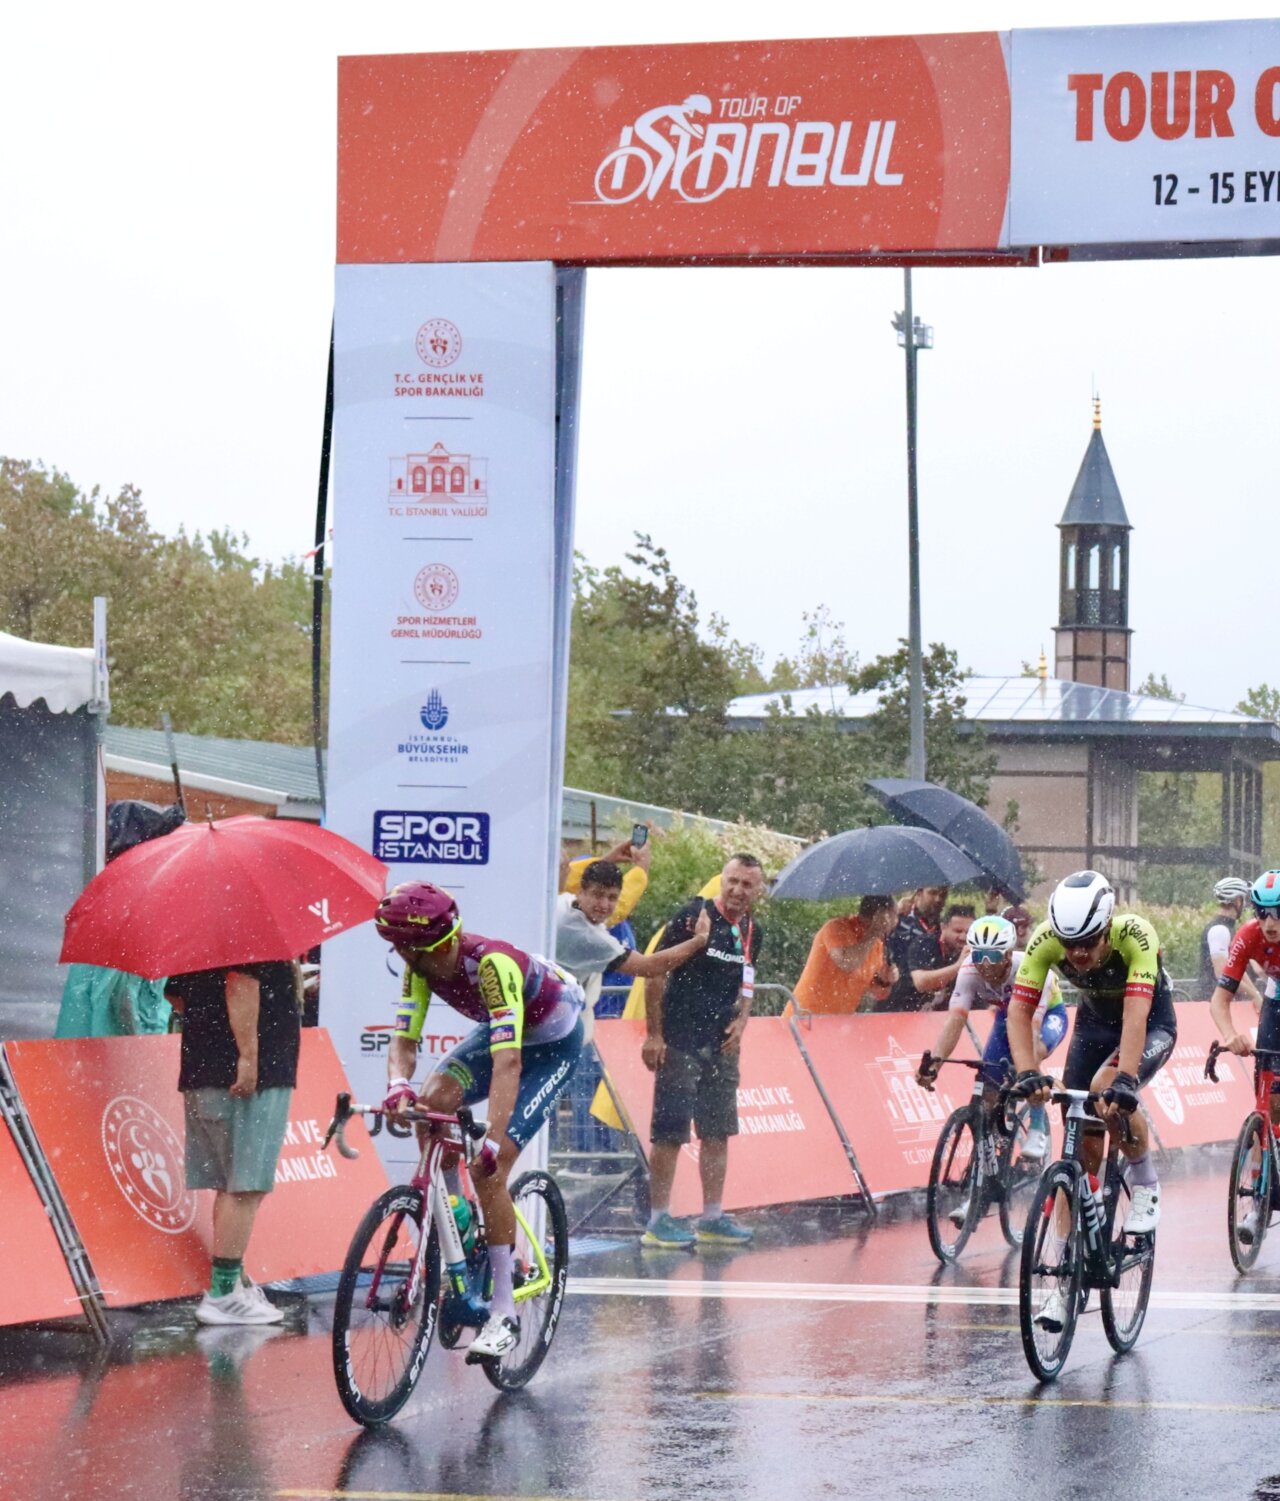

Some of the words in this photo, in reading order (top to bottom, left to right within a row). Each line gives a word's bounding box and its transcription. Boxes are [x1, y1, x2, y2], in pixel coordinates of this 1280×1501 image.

[717, 96, 766, 119] TOUR
[773, 95, 802, 117] OF
[1066, 70, 1236, 143] TOUR
[1152, 172, 1178, 206] 12
[1209, 171, 1236, 204] 15
[394, 373, 415, 384] T.C.
[418, 372, 467, 386] GENÇLİK
[470, 374, 484, 383] VE
[394, 387, 423, 397] SPOR
[425, 386, 484, 397] BAKANLIĞI
[397, 616, 422, 626] SPOR
[423, 615, 477, 626] HİZMETLERİ
[391, 629, 420, 638] GENEL
[397, 743, 469, 755] BÜYÜKŞEHİR
[379, 815, 482, 842] SPOR
[296, 1119, 324, 1144] VE
[1064, 1120, 1078, 1156] BMC
